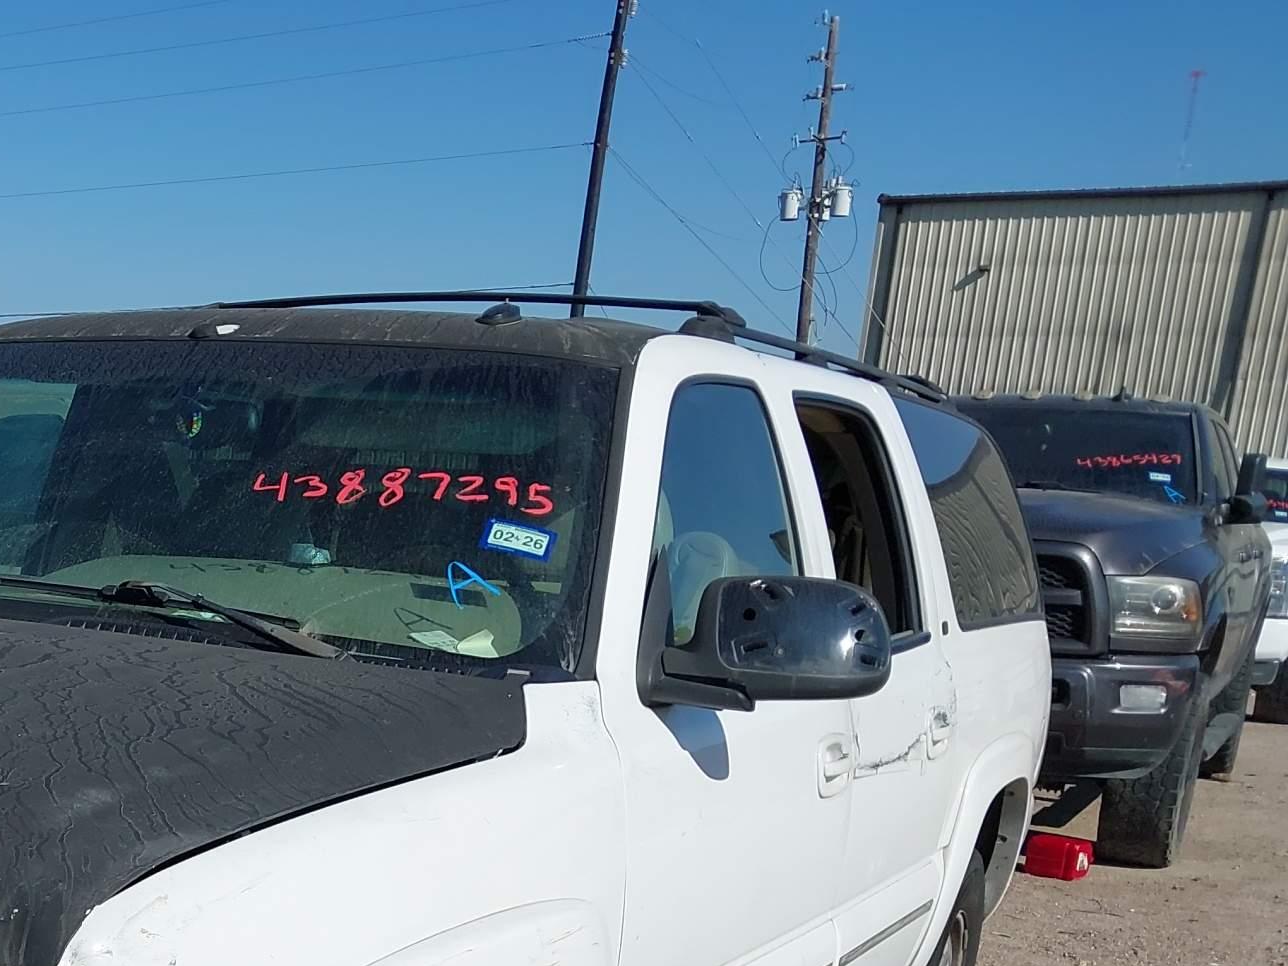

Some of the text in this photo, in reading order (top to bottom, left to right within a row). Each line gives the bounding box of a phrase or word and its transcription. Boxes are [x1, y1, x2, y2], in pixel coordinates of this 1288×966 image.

[253, 468, 554, 515] 43887295
[493, 529, 545, 550] 02 26
[448, 561, 502, 610] A
